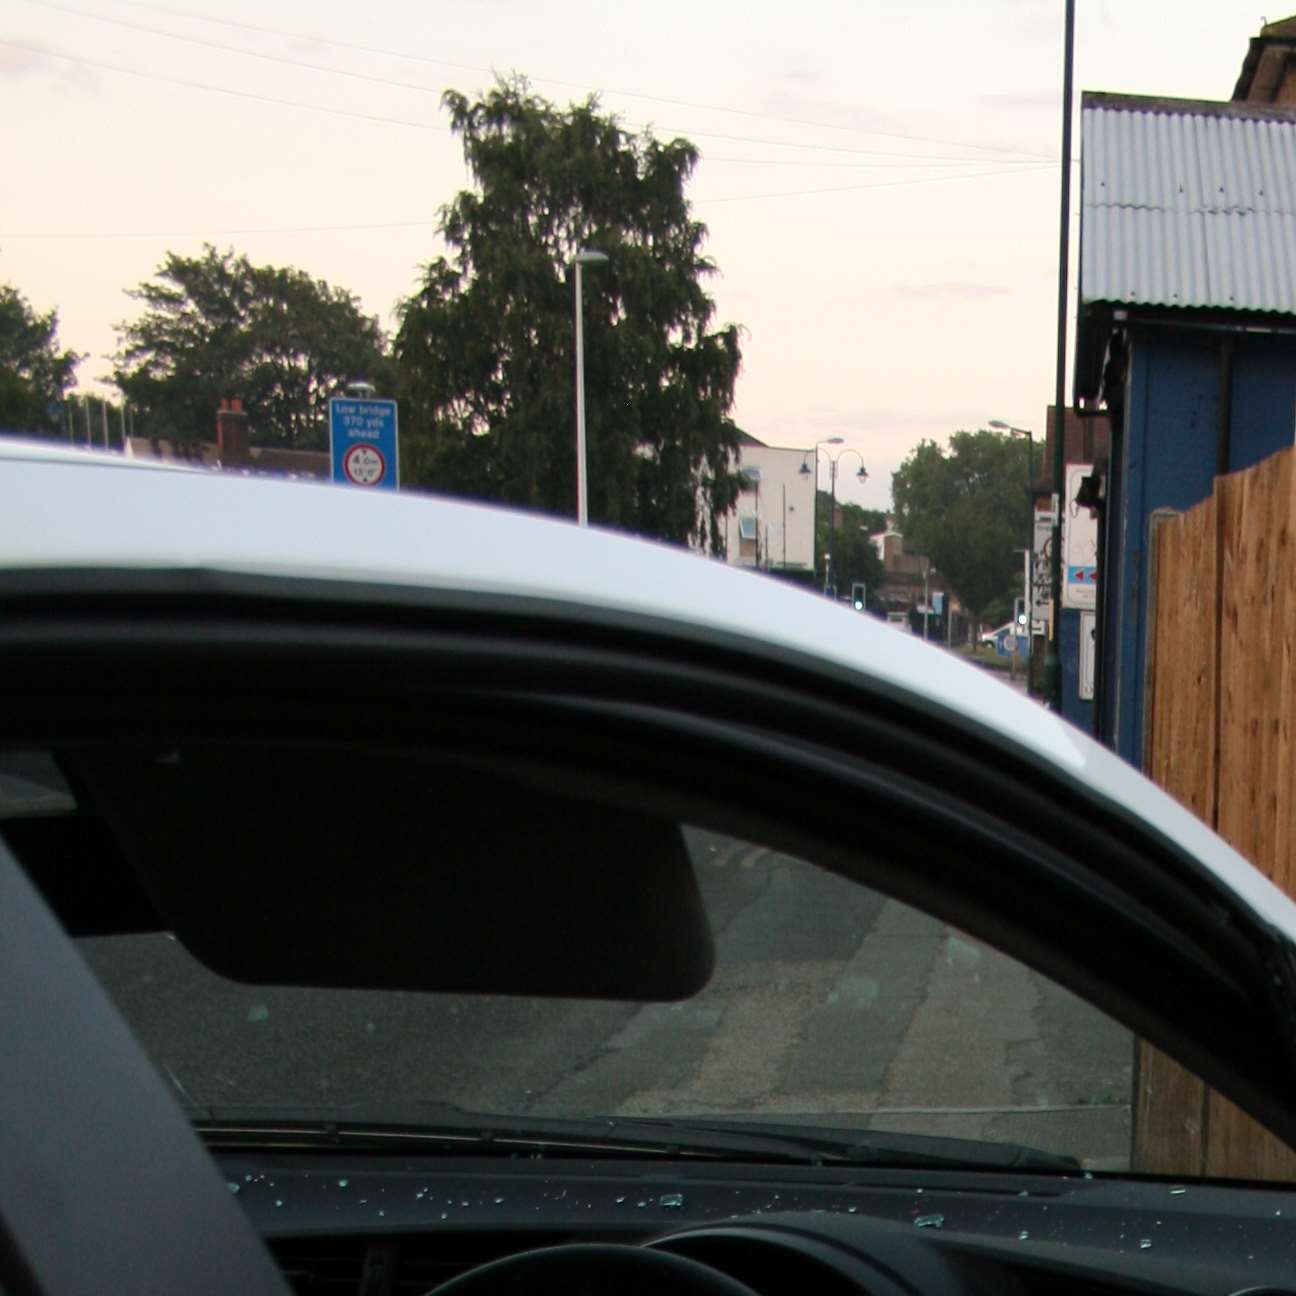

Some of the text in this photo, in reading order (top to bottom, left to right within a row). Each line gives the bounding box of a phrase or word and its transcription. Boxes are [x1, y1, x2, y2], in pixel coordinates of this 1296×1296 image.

[335, 403, 392, 417] Low bridge
[366, 417, 384, 429] yds
[348, 429, 380, 439] ahead
